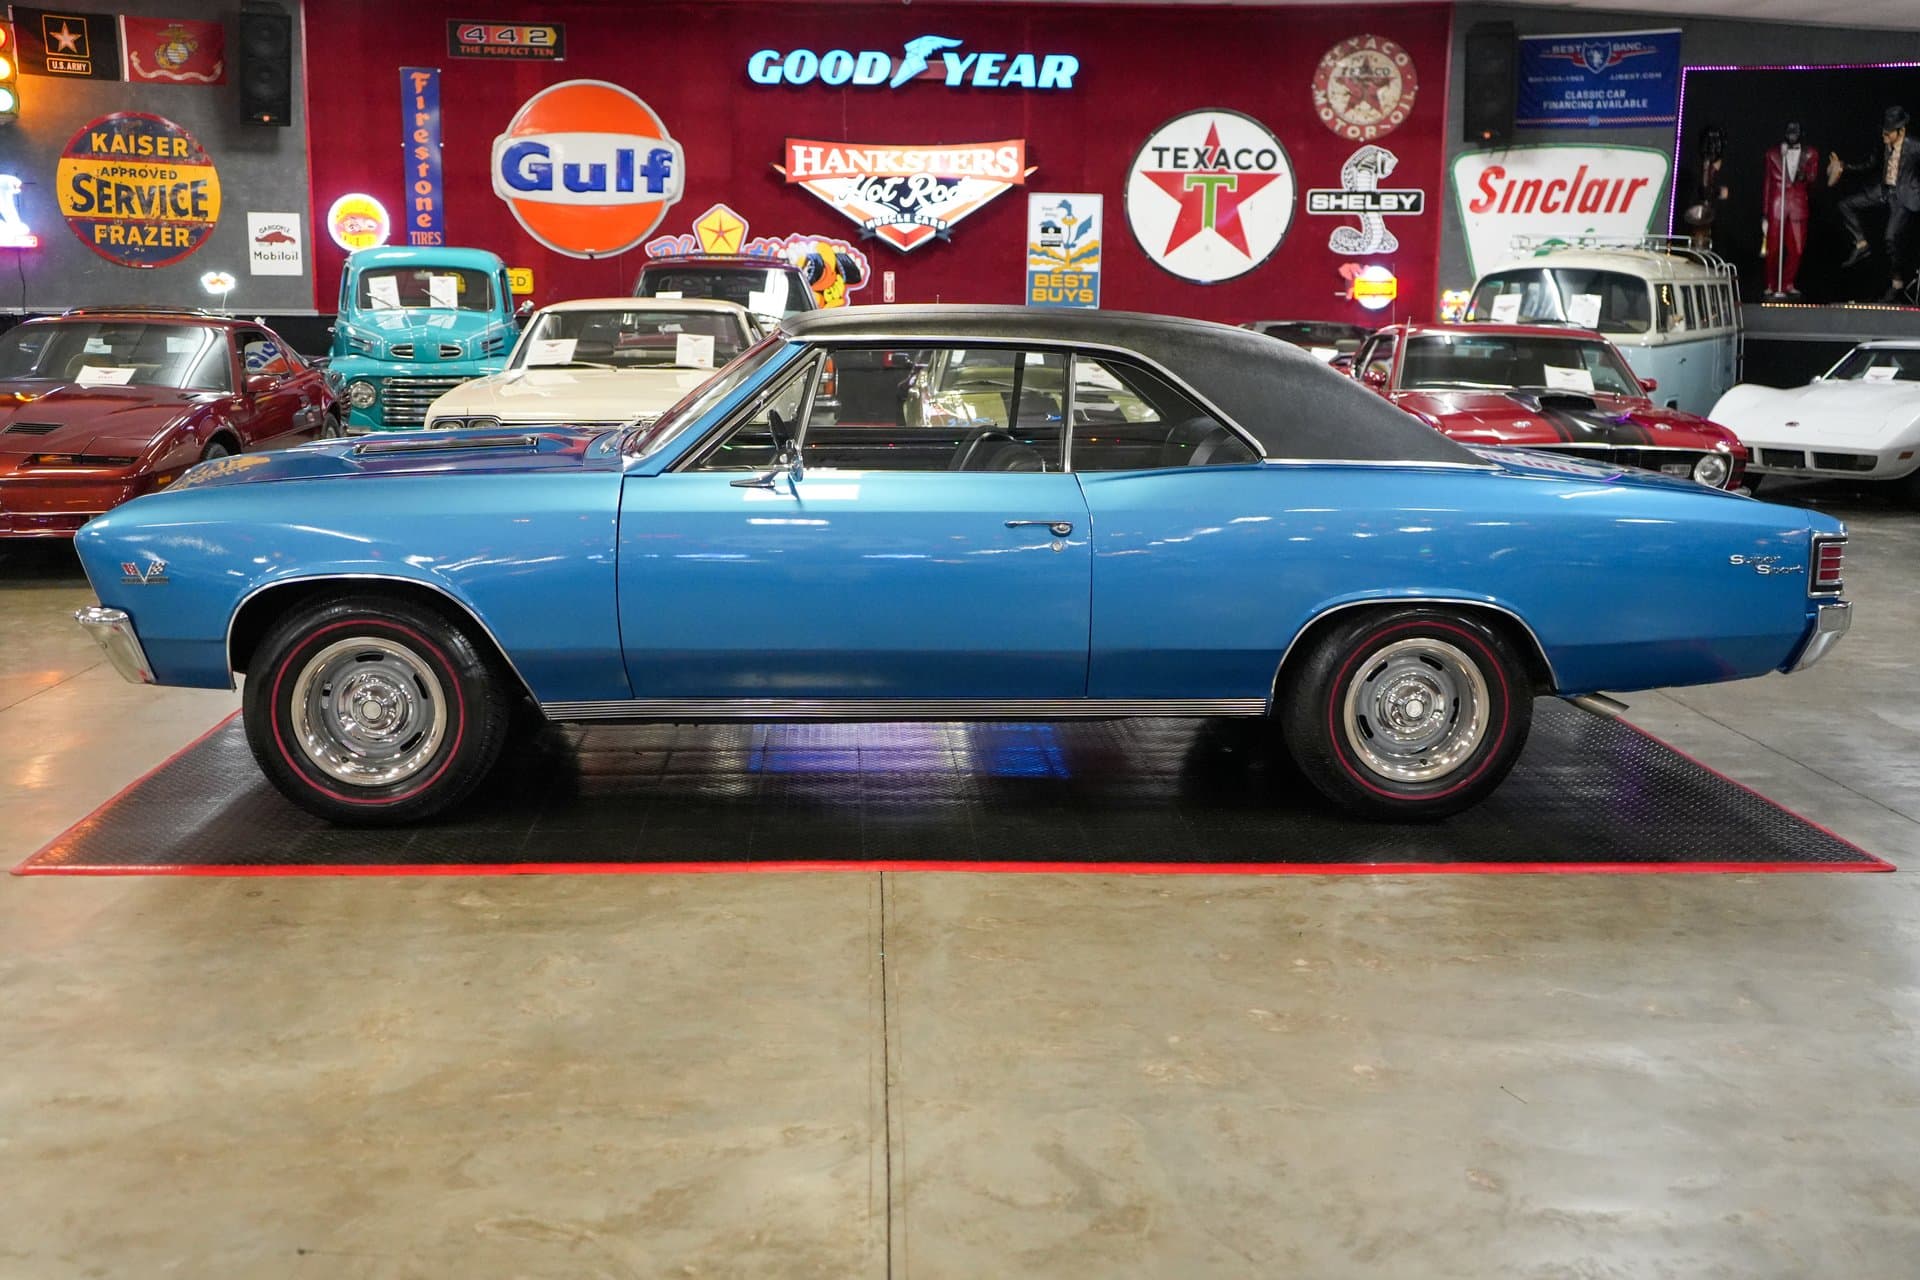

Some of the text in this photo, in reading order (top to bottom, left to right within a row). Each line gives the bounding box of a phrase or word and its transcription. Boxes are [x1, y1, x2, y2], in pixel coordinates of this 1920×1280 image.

[460, 45, 554, 56] THE PERFECT TEN
[1551, 45, 1582, 53] BEST
[51, 61, 87, 71] U.S. ARMY
[1565, 89, 1627, 100] CLASSIC CAR
[1543, 99, 1648, 110] FINANCING AVAILABLE
[91, 132, 188, 158] KAISER
[410, 72, 433, 228] Firestone
[501, 141, 673, 193] Gulf
[792, 145, 1019, 178] HANKSTERS
[1151, 146, 1278, 171] TEXACO
[99, 167, 178, 181] APPROVED
[71, 173, 209, 218] SERVICE
[838, 173, 904, 203] Hot
[1468, 164, 1649, 214] Sinclair
[1311, 192, 1418, 212] SHELBY
[866, 213, 947, 230] MUSCLE CARS
[94, 224, 190, 248] FRAZER
[410, 232, 442, 246] TIRES
[253, 251, 299, 261] Mobiloil
[1034, 273, 1094, 289] BEST
[1032, 287, 1095, 304] BUYS
